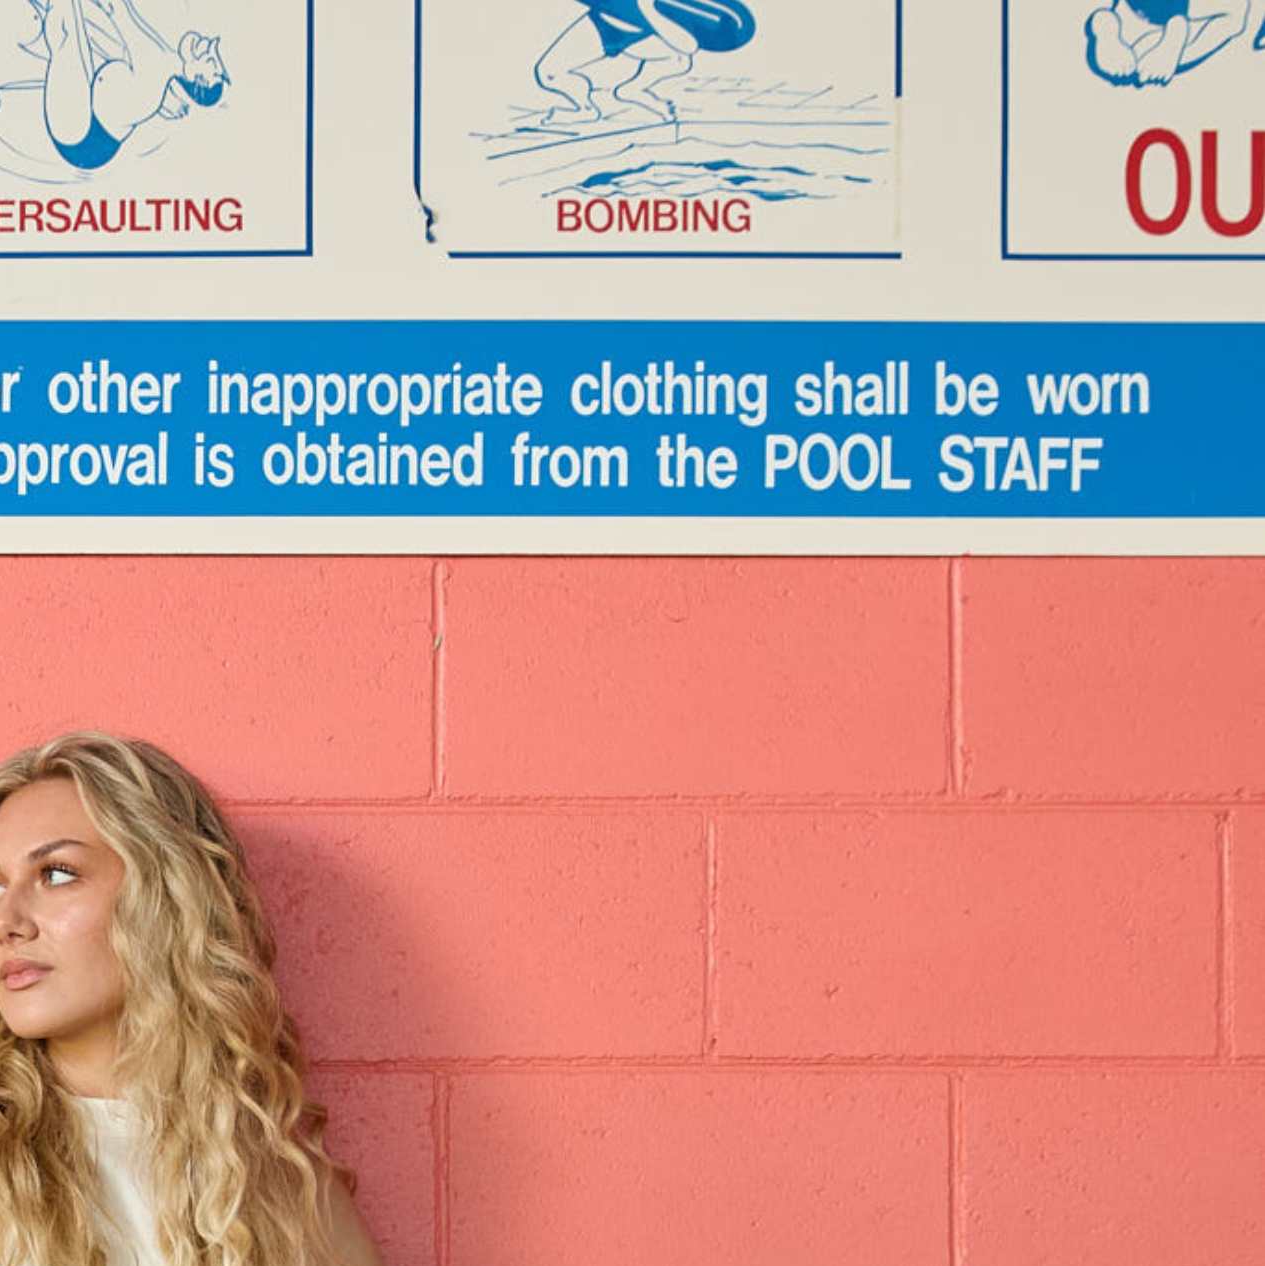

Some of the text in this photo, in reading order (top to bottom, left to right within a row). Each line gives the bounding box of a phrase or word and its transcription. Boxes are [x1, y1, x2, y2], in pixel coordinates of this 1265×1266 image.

[556, 198, 752, 235] BOMBING
[48, 359, 182, 416] other
[208, 359, 544, 428] inappropriate
[570, 360, 768, 428] clothing
[795, 360, 910, 417] shall
[935, 360, 1000, 417] be
[1026, 372, 1151, 416] worn
[194, 432, 235, 488] is
[262, 431, 485, 488] obtained
[511, 431, 630, 488] from
[656, 433, 739, 490] the
[764, 432, 912, 492] POOL
[938, 434, 1104, 493] STAFF
